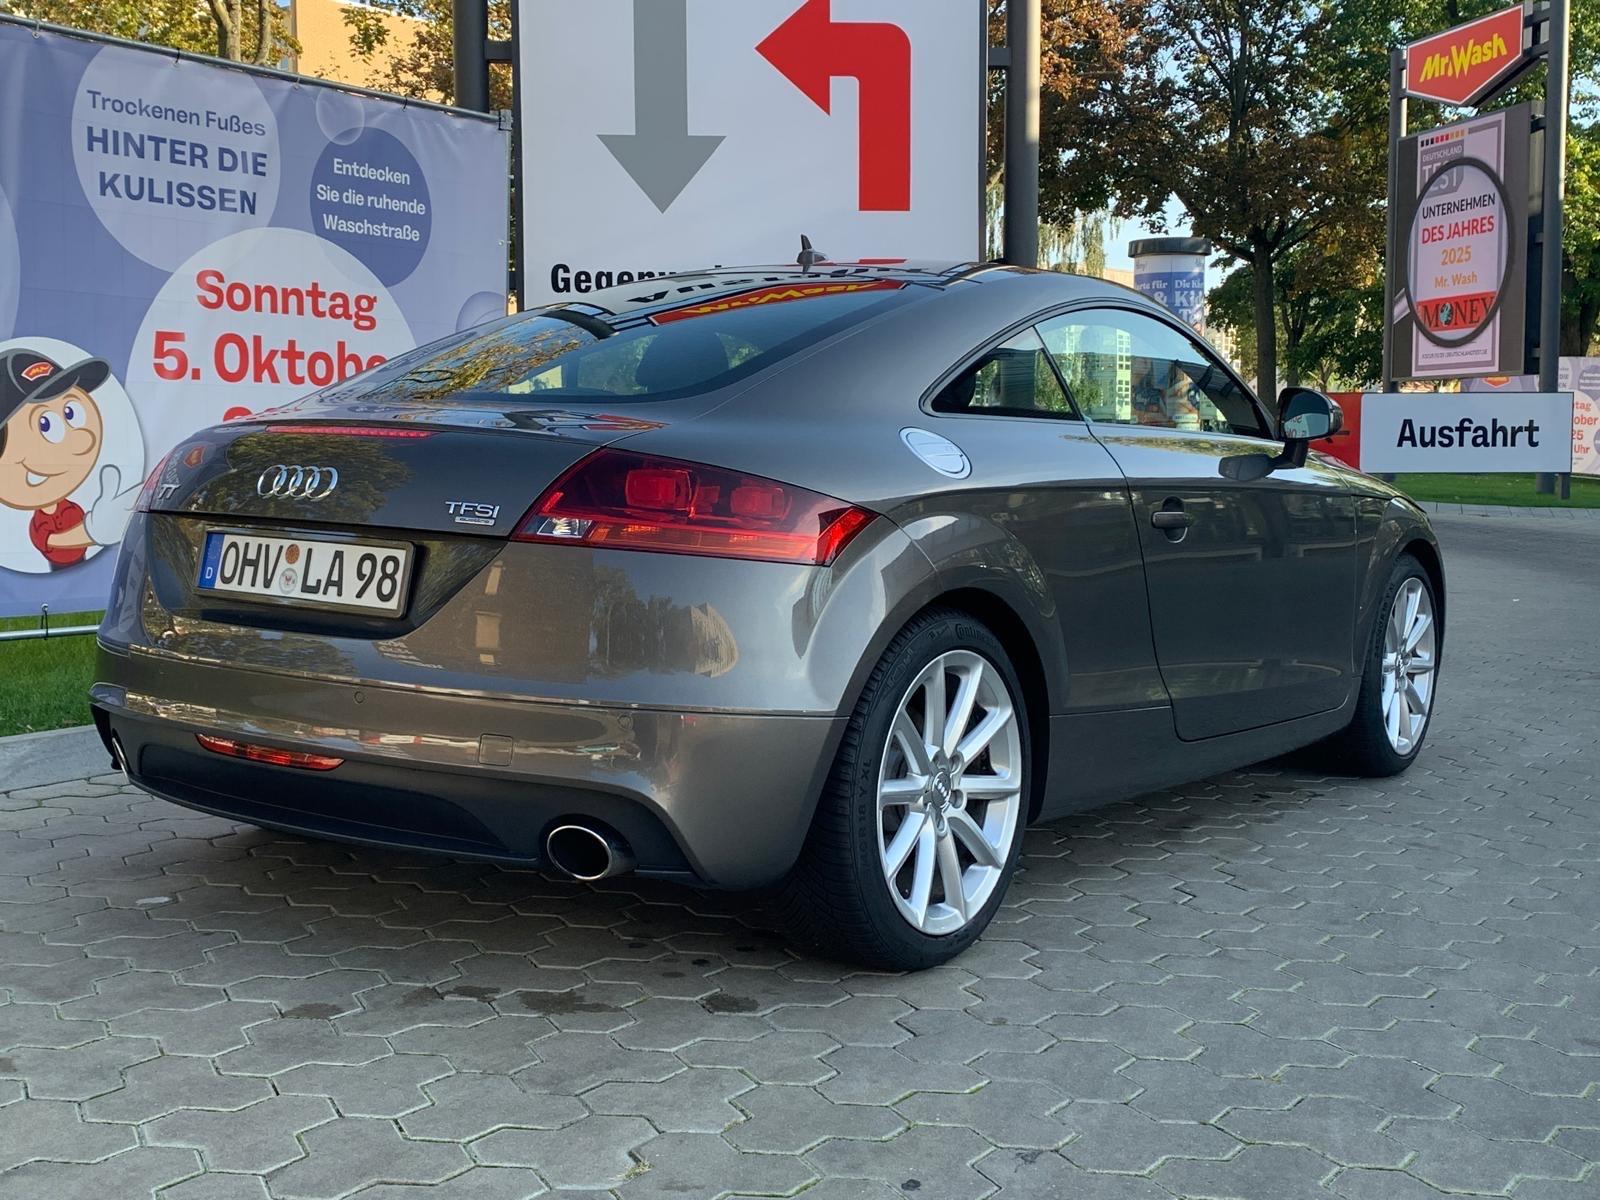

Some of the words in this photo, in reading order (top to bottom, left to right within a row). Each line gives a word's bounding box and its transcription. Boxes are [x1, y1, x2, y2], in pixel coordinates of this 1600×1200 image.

[86, 89, 200, 126] Trockenen
[205, 111, 266, 137] Fußes
[86, 126, 208, 169] HINTER
[216, 146, 267, 178] DIE
[1423, 146, 1462, 162] DEUTSCHLAND
[333, 158, 411, 186] Entdecken
[99, 171, 257, 216] KULISSEN
[316, 184, 341, 202] Sie
[342, 188, 364, 206] die
[367, 194, 426, 216] ruhende
[1422, 193, 1496, 219] UNTERNEHMEN
[322, 213, 420, 243] Waschstraße
[1422, 225, 1444, 244] DES
[1446, 215, 1495, 240] JAHRES
[1441, 246, 1472, 266] 2025
[1434, 276, 1450, 289] Mr.
[1452, 271, 1478, 286] Wash
[195, 269, 378, 331] Sonntag
[152, 331, 200, 382] 5.
[1396, 417, 1540, 448] Ausfahrt
[1573, 414, 1599, 425] ober
[1571, 429, 1584, 440] 25
[1573, 444, 1590, 454] Uhr
[157, 483, 182, 500] TT
[445, 501, 500, 519] TFSI
[205, 566, 214, 579] D
[219, 541, 284, 589] OHV
[301, 548, 345, 597] LA
[355, 552, 400, 603] 98
